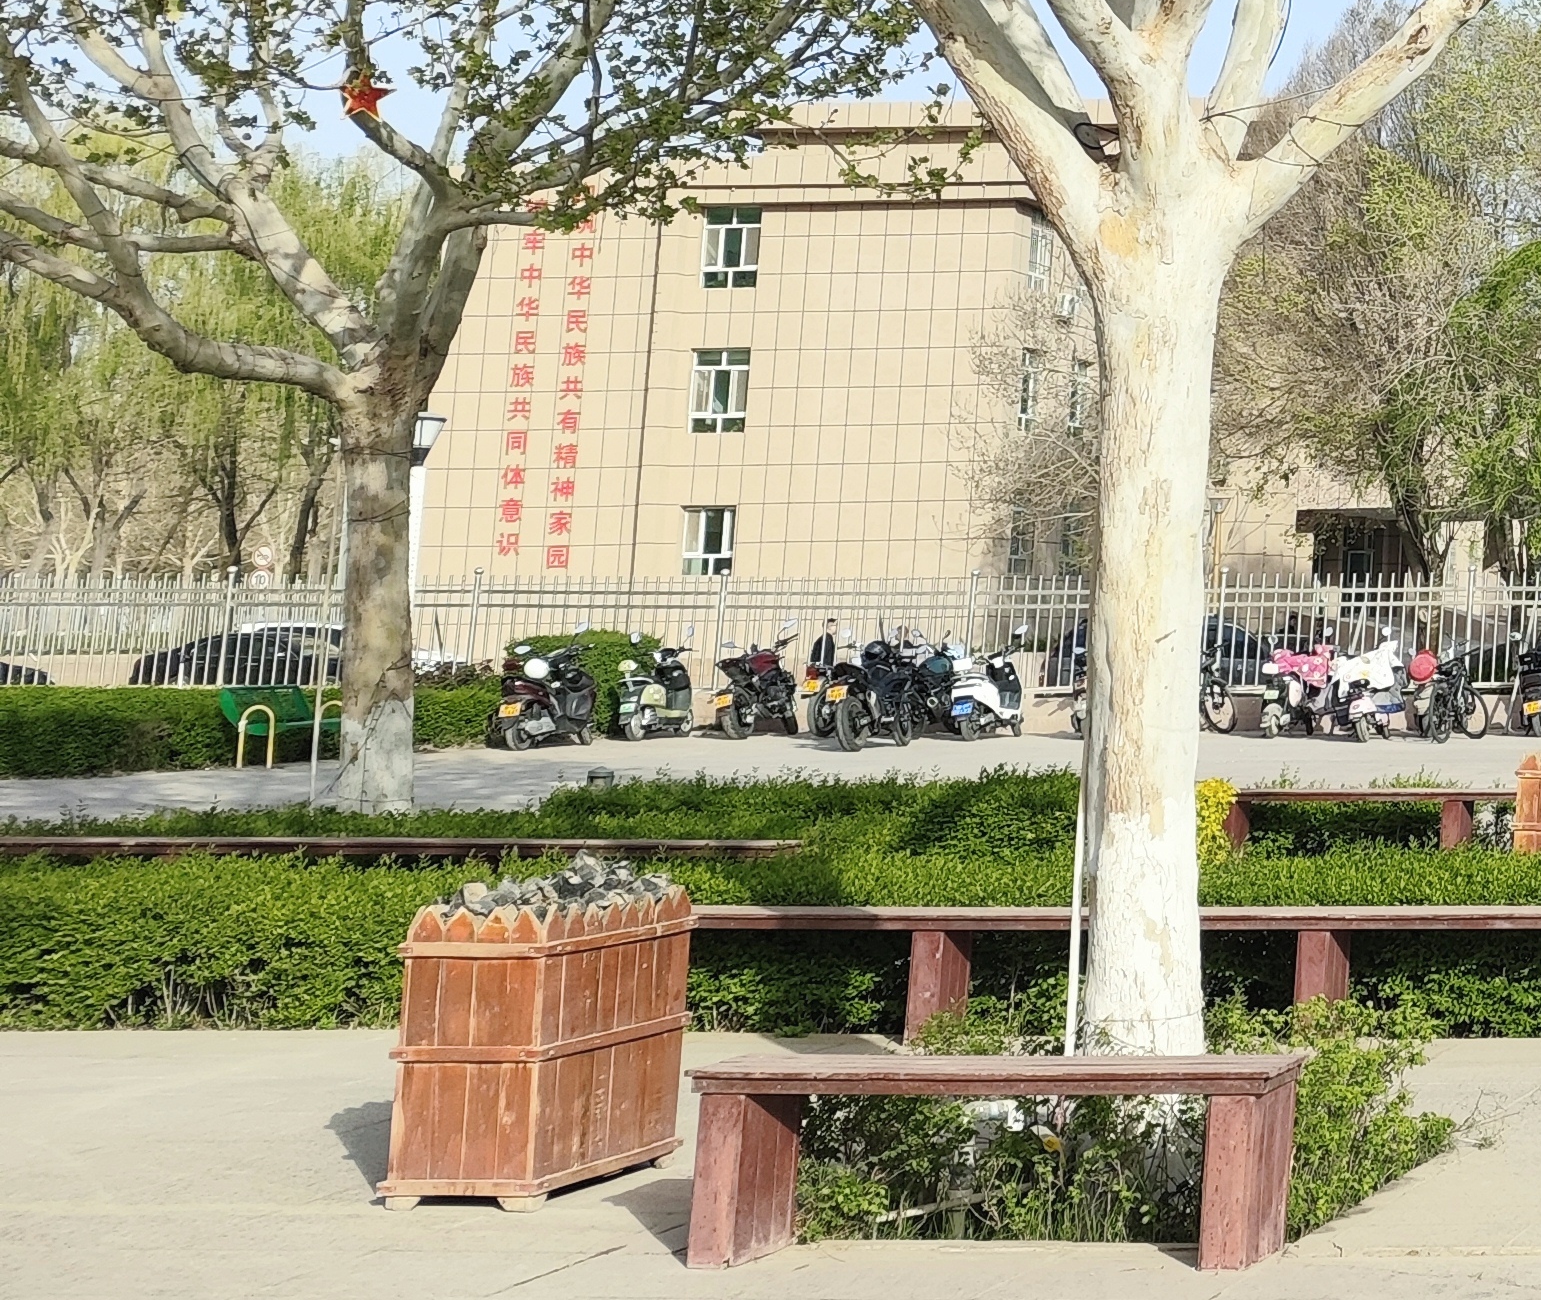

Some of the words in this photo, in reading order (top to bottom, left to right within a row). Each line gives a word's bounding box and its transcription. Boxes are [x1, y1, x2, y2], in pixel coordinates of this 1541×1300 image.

[546, 184, 598, 569] 中华民族共有精神家园
